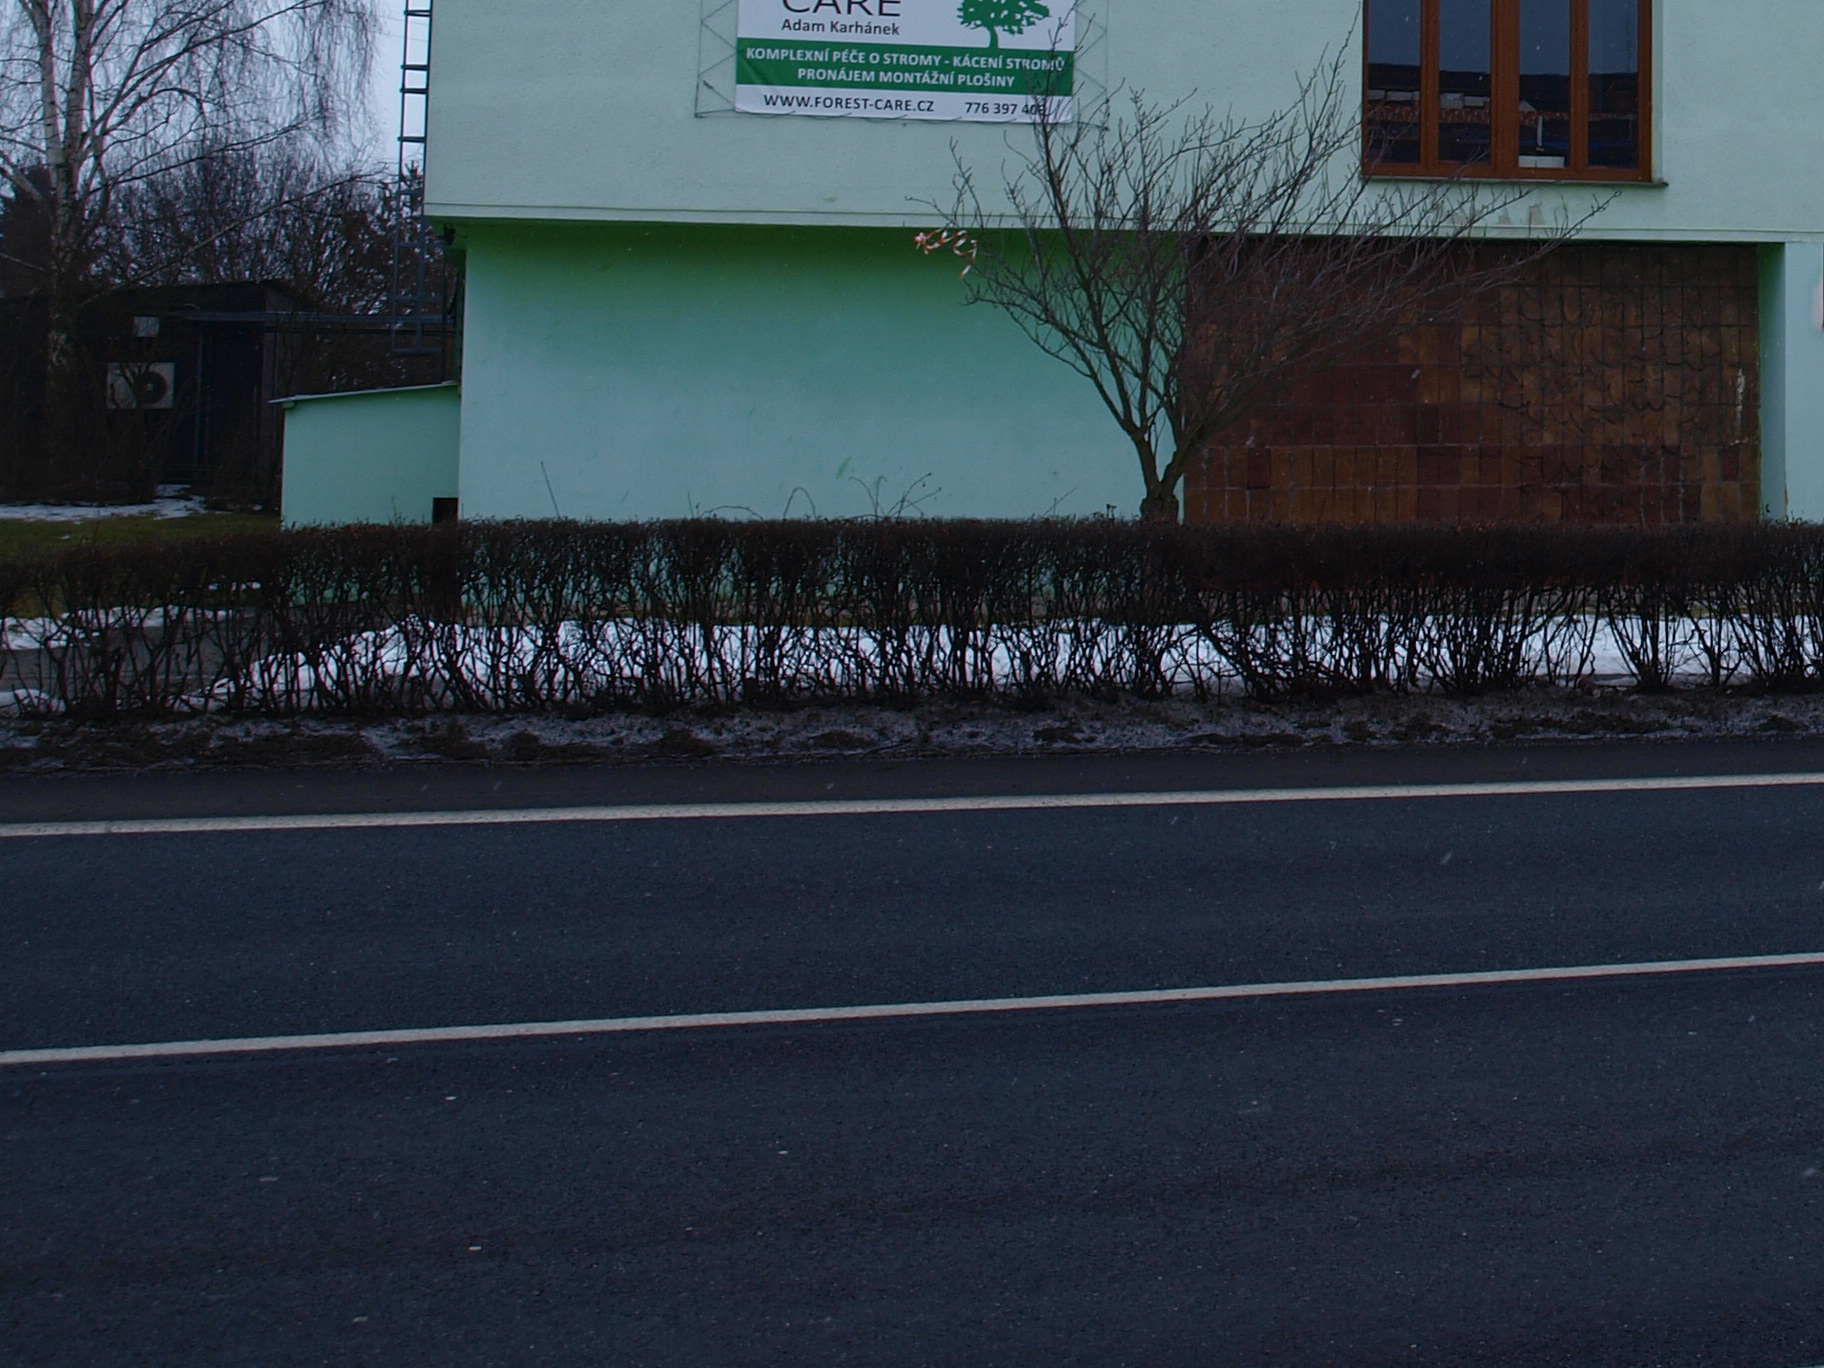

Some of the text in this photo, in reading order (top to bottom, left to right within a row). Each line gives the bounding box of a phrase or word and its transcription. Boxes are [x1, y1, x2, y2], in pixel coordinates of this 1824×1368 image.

[781, 19, 900, 35] Adam Karhánek
[746, 47, 830, 61] KOMPLEXNÍ
[832, 49, 866, 63] PÉČE
[869, 54, 880, 64] O
[883, 53, 942, 67] STROMY
[953, 53, 1003, 69] KÁCENÍ
[798, 67, 1015, 87] PRONÁJEM MONTÁŽNÍ PLOŠINY
[764, 94, 934, 113] WWW.FOREST-CARE.CZ
[965, 101, 989, 114] 776
[993, 103, 1017, 115] 397
